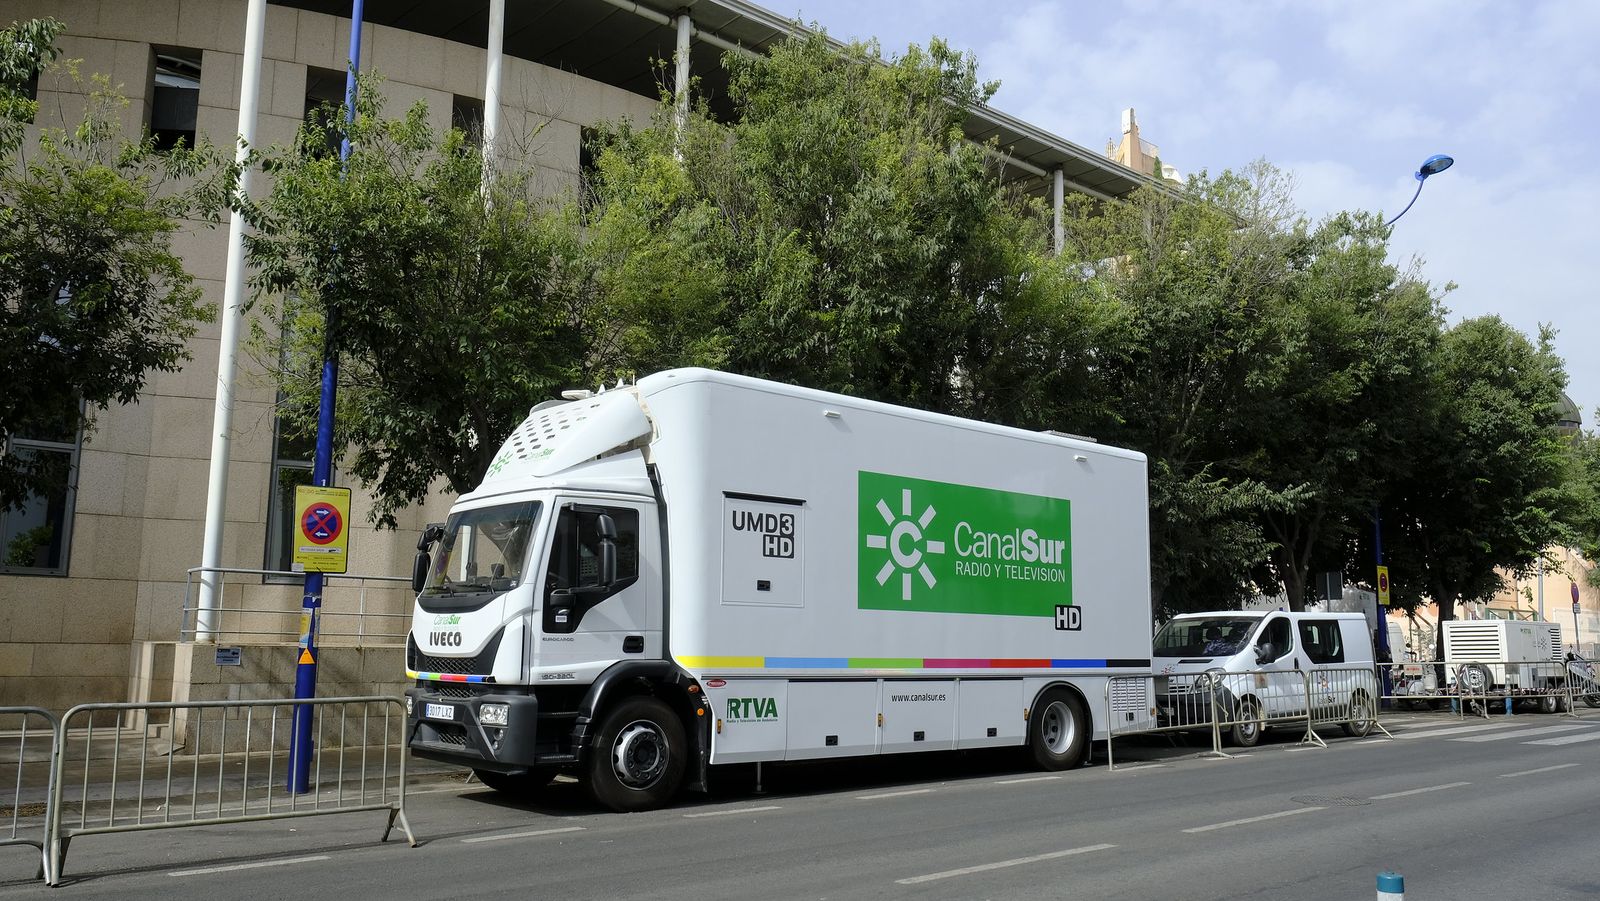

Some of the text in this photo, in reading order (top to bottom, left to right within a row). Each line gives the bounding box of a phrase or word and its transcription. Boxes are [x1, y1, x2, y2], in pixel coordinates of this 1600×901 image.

[732, 510, 794, 536] UMD3
[763, 534, 794, 558] HD
[953, 521, 1065, 564] CanalSur
[955, 560, 1065, 583] RADIO Y TELEVISION
[1055, 605, 1081, 630] HD
[429, 631, 462, 647] IVECO
[726, 697, 778, 719] RTVA
[891, 693, 946, 702] www.canalsur.es
